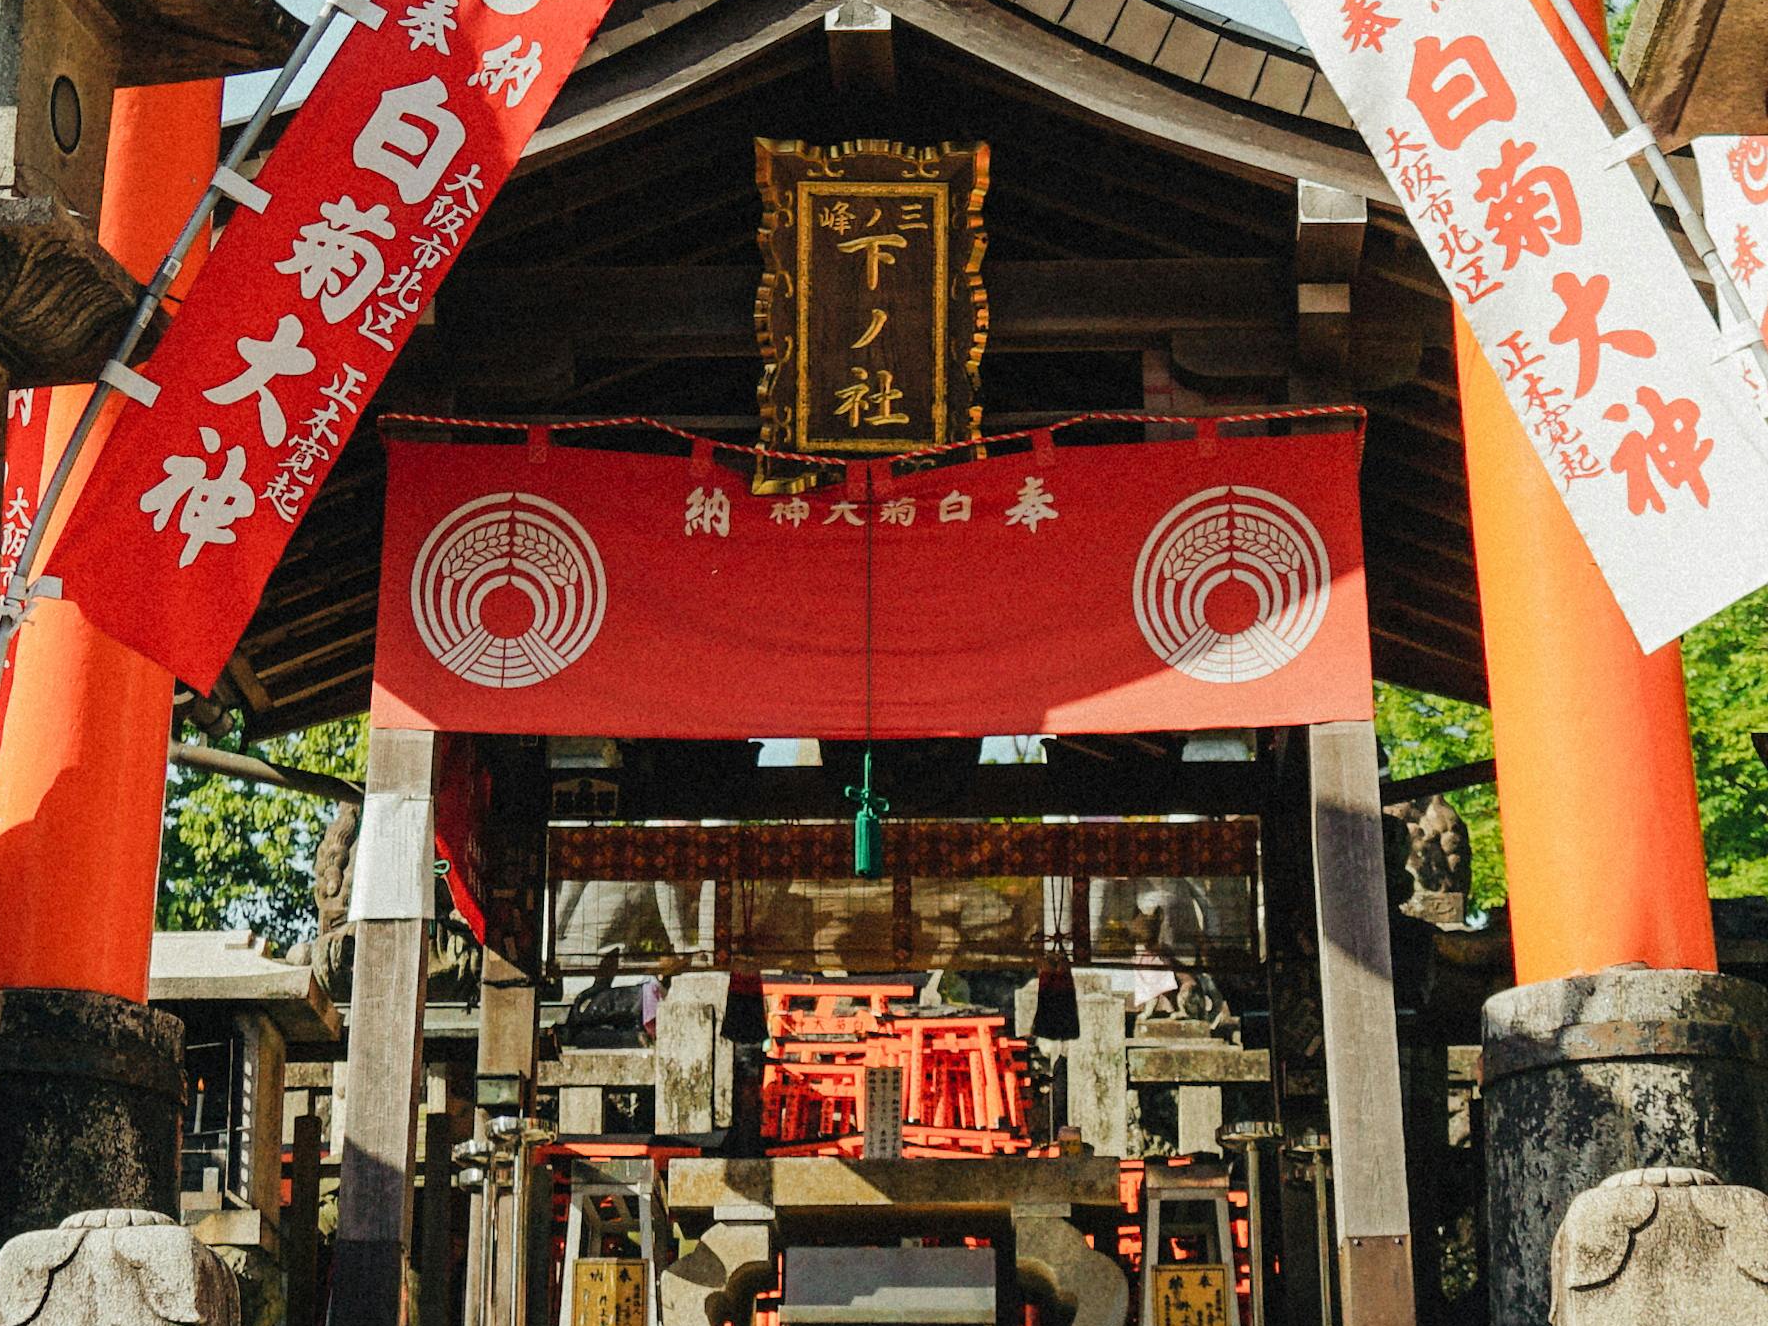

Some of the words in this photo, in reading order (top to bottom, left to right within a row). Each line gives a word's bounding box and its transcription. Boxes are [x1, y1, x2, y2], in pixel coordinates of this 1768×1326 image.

[359, 164, 484, 352] 大阪市北区
[819, 201, 928, 235] 三ノ峰
[1387, 129, 1504, 304] 大阪市北区
[1408, 36, 1711, 515] 白菊大神
[141, 80, 463, 566] 白菊大神
[834, 234, 910, 428] 下ノ社
[685, 486, 731, 539] 納
[769, 490, 972, 528] 白菊大神
[1005, 477, 1059, 533] 奉
